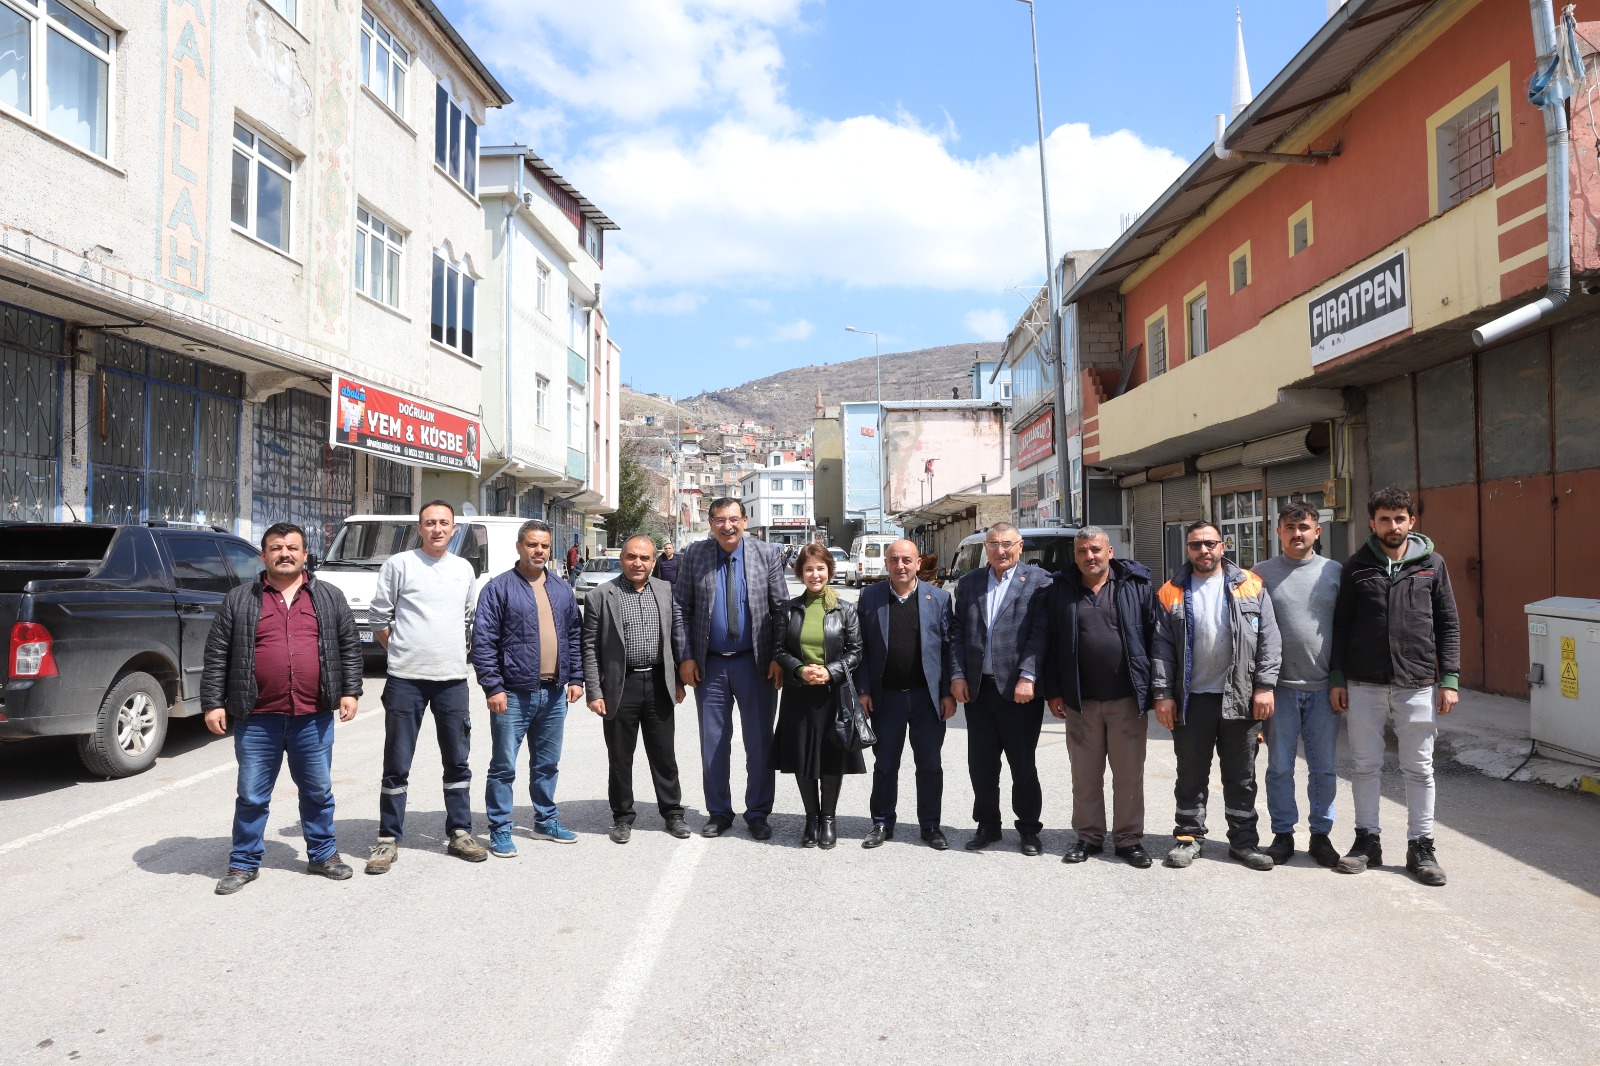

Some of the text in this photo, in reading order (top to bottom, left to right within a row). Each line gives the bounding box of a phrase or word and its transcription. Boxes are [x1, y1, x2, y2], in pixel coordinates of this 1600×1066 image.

[1312, 263, 1402, 338] FIRATPEN
[367, 410, 401, 439] YEM
[405, 425, 415, 443] &
[420, 425, 463, 453] KÜSBE
[398, 403, 435, 423] DOĞRULUK
